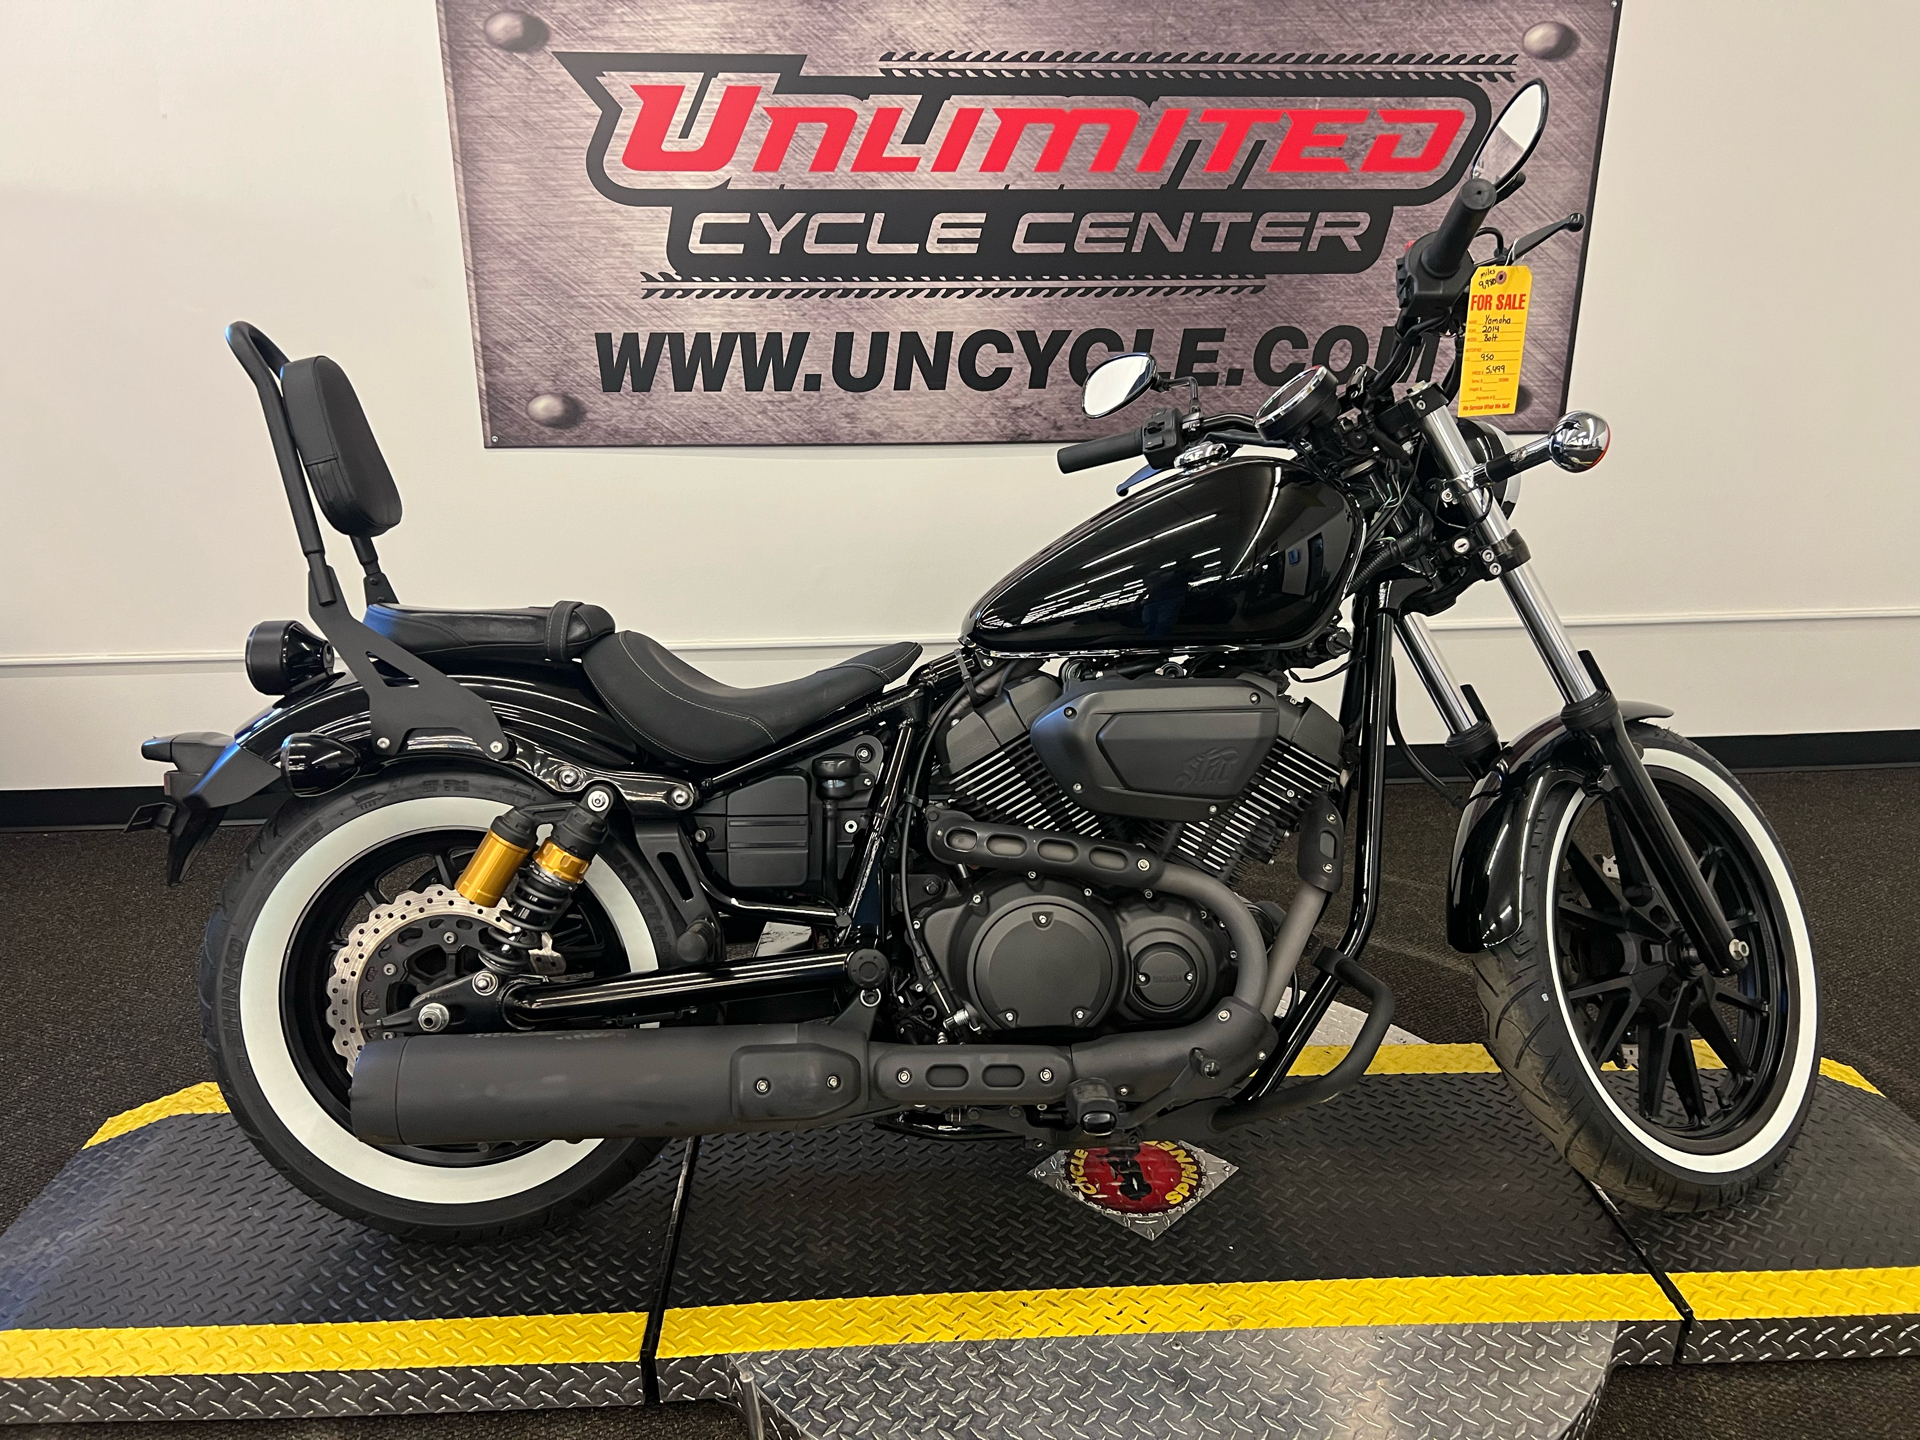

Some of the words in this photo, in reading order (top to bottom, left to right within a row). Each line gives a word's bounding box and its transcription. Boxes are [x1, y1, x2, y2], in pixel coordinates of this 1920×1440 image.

[688, 212, 987, 255] CYCLE
[1011, 211, 1371, 254] CENTER
[1480, 268, 1496, 279] miles
[1470, 294, 1493, 311] FOR
[1496, 294, 1527, 310] SALE
[1484, 314, 1511, 325] Yamaha
[1482, 325, 1500, 333] 2014
[1485, 365, 1505, 374] 5,499
[220, 937, 244, 1049] SHINKO
[1069, 1148, 1097, 1195] CYCLE
